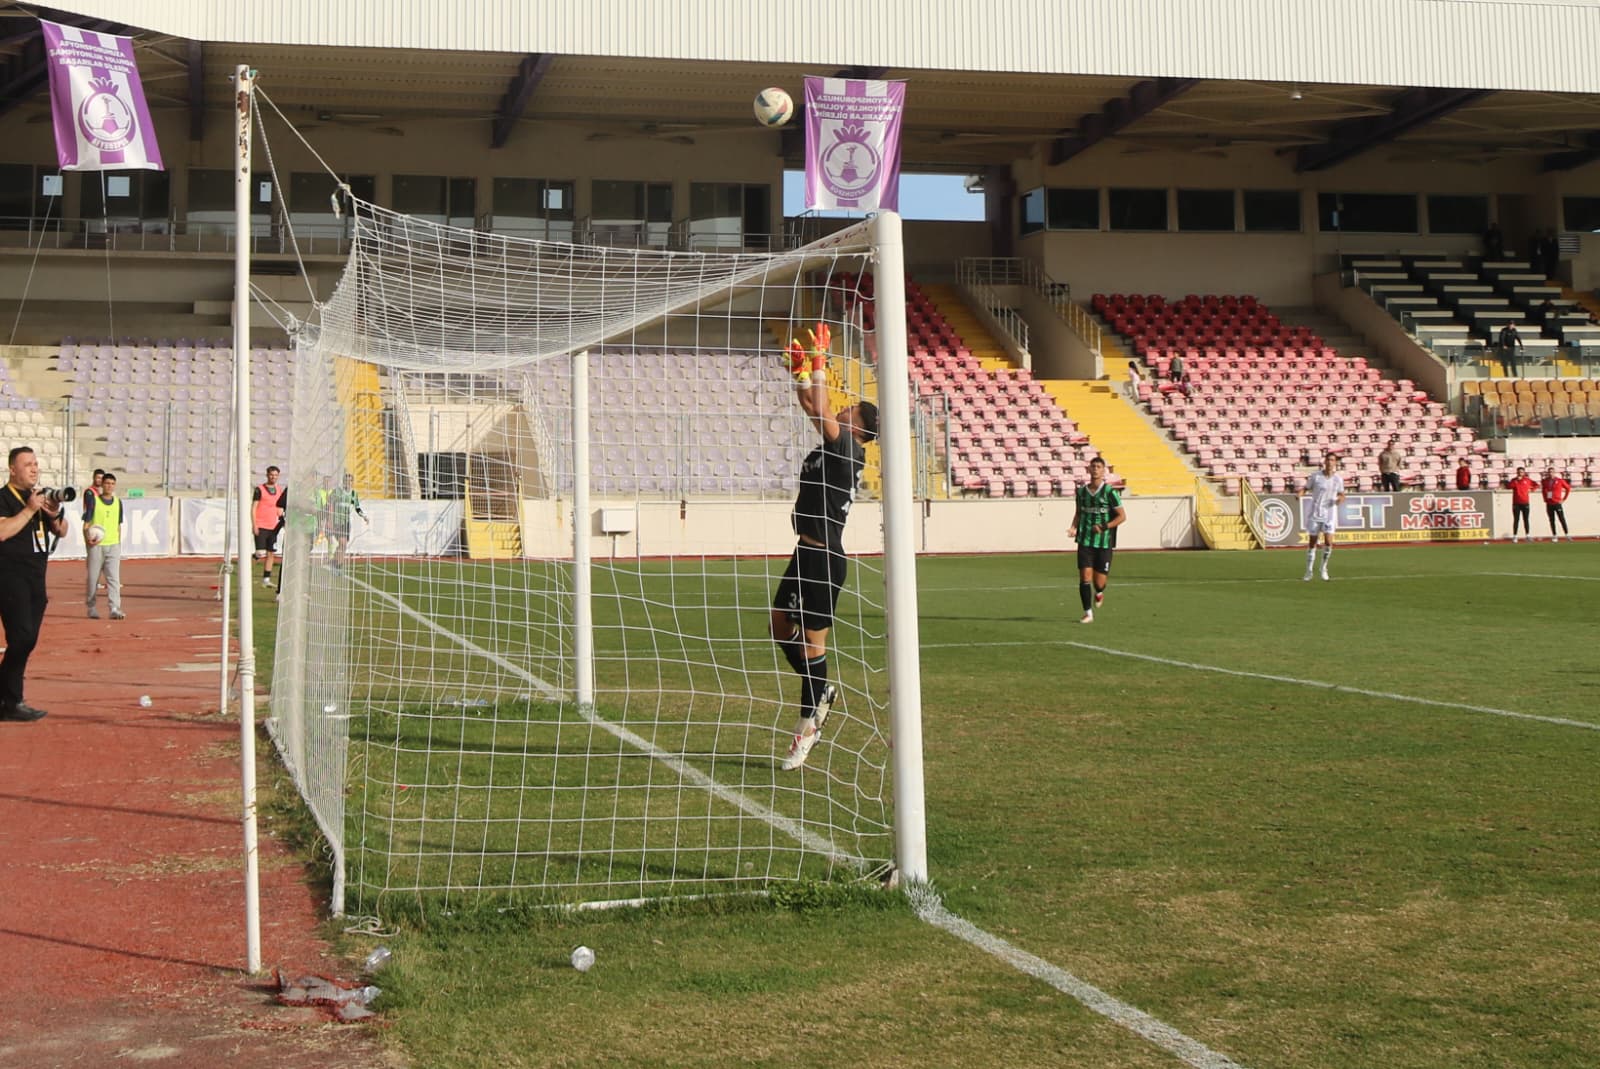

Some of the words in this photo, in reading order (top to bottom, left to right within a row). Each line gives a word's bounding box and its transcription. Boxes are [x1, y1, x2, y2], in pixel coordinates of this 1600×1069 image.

[1300, 495, 1393, 529] ET
[1410, 494, 1475, 513] SÜPER
[1401, 512, 1485, 530] MARKET
